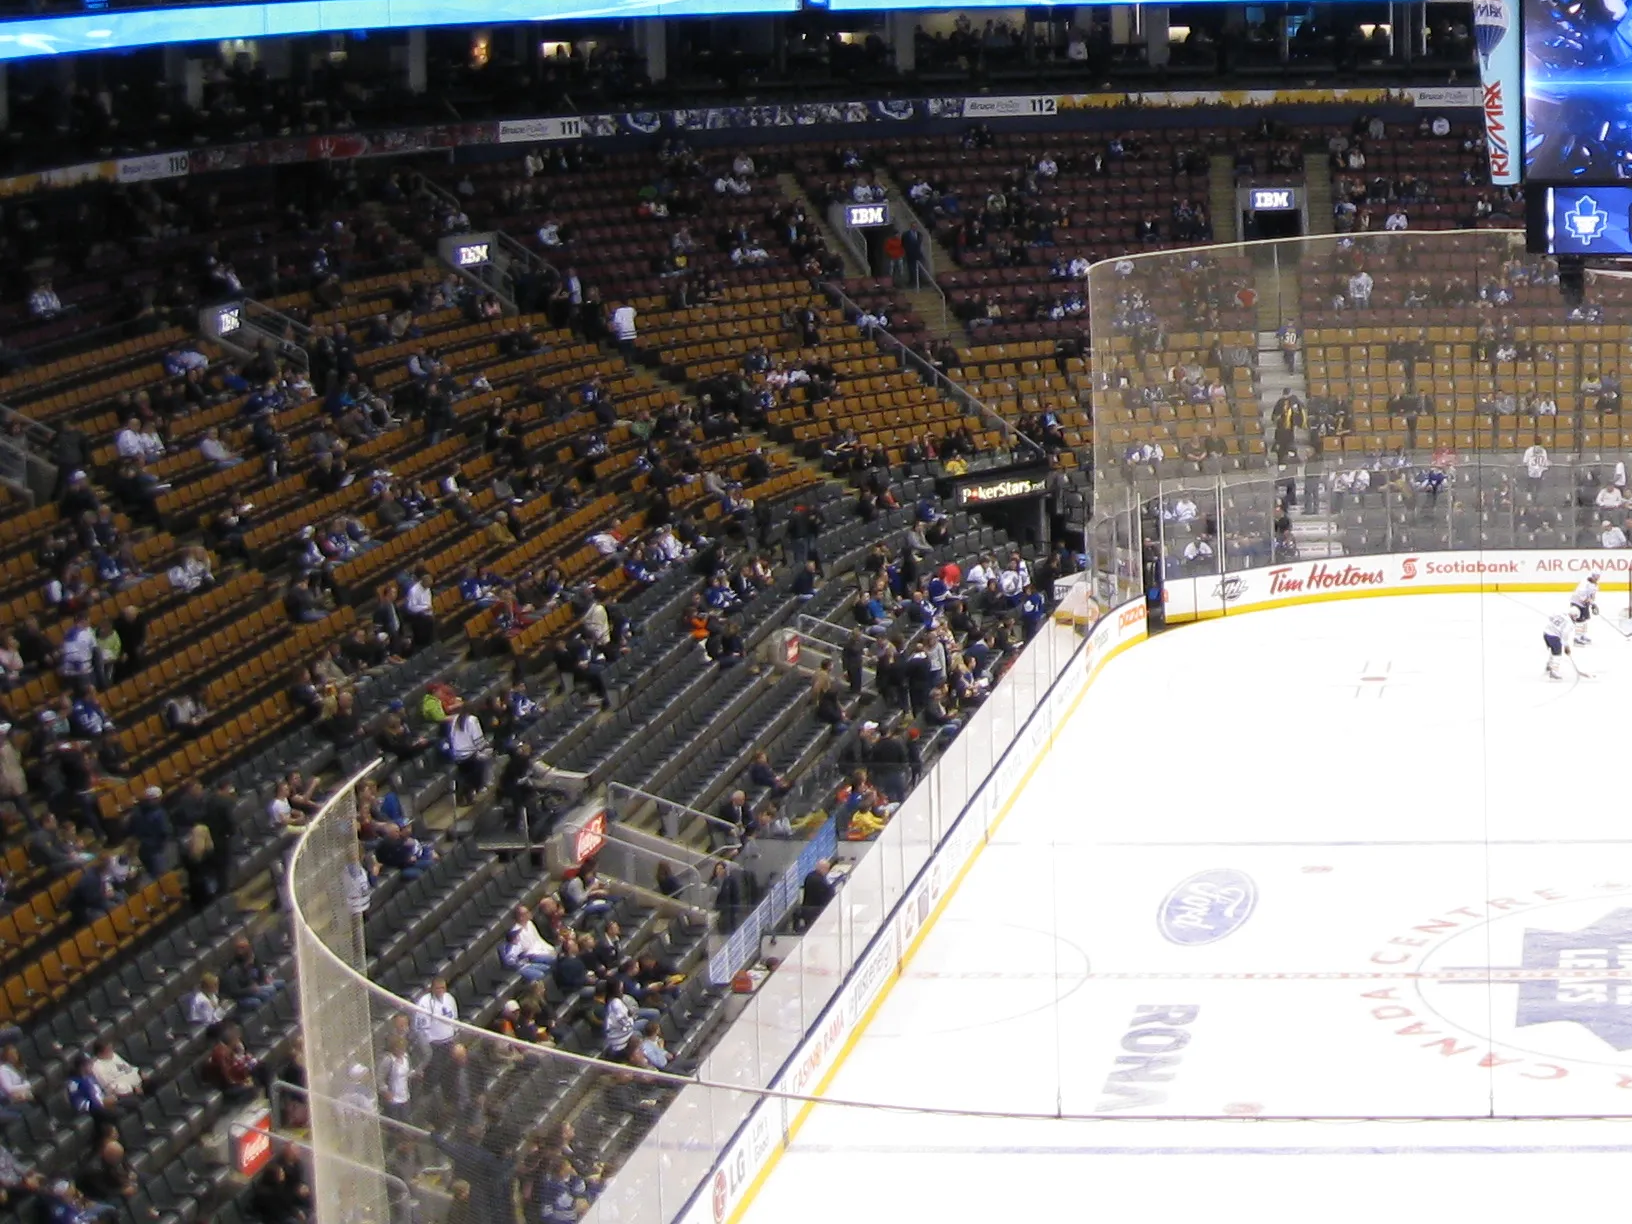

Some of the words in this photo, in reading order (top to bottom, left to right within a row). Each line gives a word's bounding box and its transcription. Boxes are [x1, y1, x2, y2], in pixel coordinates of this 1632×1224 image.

[1419, 92, 1444, 100] Bruce
[1031, 99, 1055, 113] 112
[561, 121, 580, 135] 111
[1482, 79, 1510, 177] RE/MAX
[169, 157, 188, 173] 110
[1255, 191, 1289, 209] IBM
[851, 207, 884, 225] IBM
[962, 479, 1047, 504] PokerStars.net
[1426, 560, 1519, 574] Scotiabank
[1536, 558, 1564, 572] AIR
[1268, 567, 1303, 595] Tim
[1306, 563, 1385, 589] Hortons
[1368, 886, 1567, 968] CENTRE
[823, 1009, 845, 1056] RAMA
[1359, 986, 1571, 1084] CANADA
[728, 1147, 747, 1198] LG
